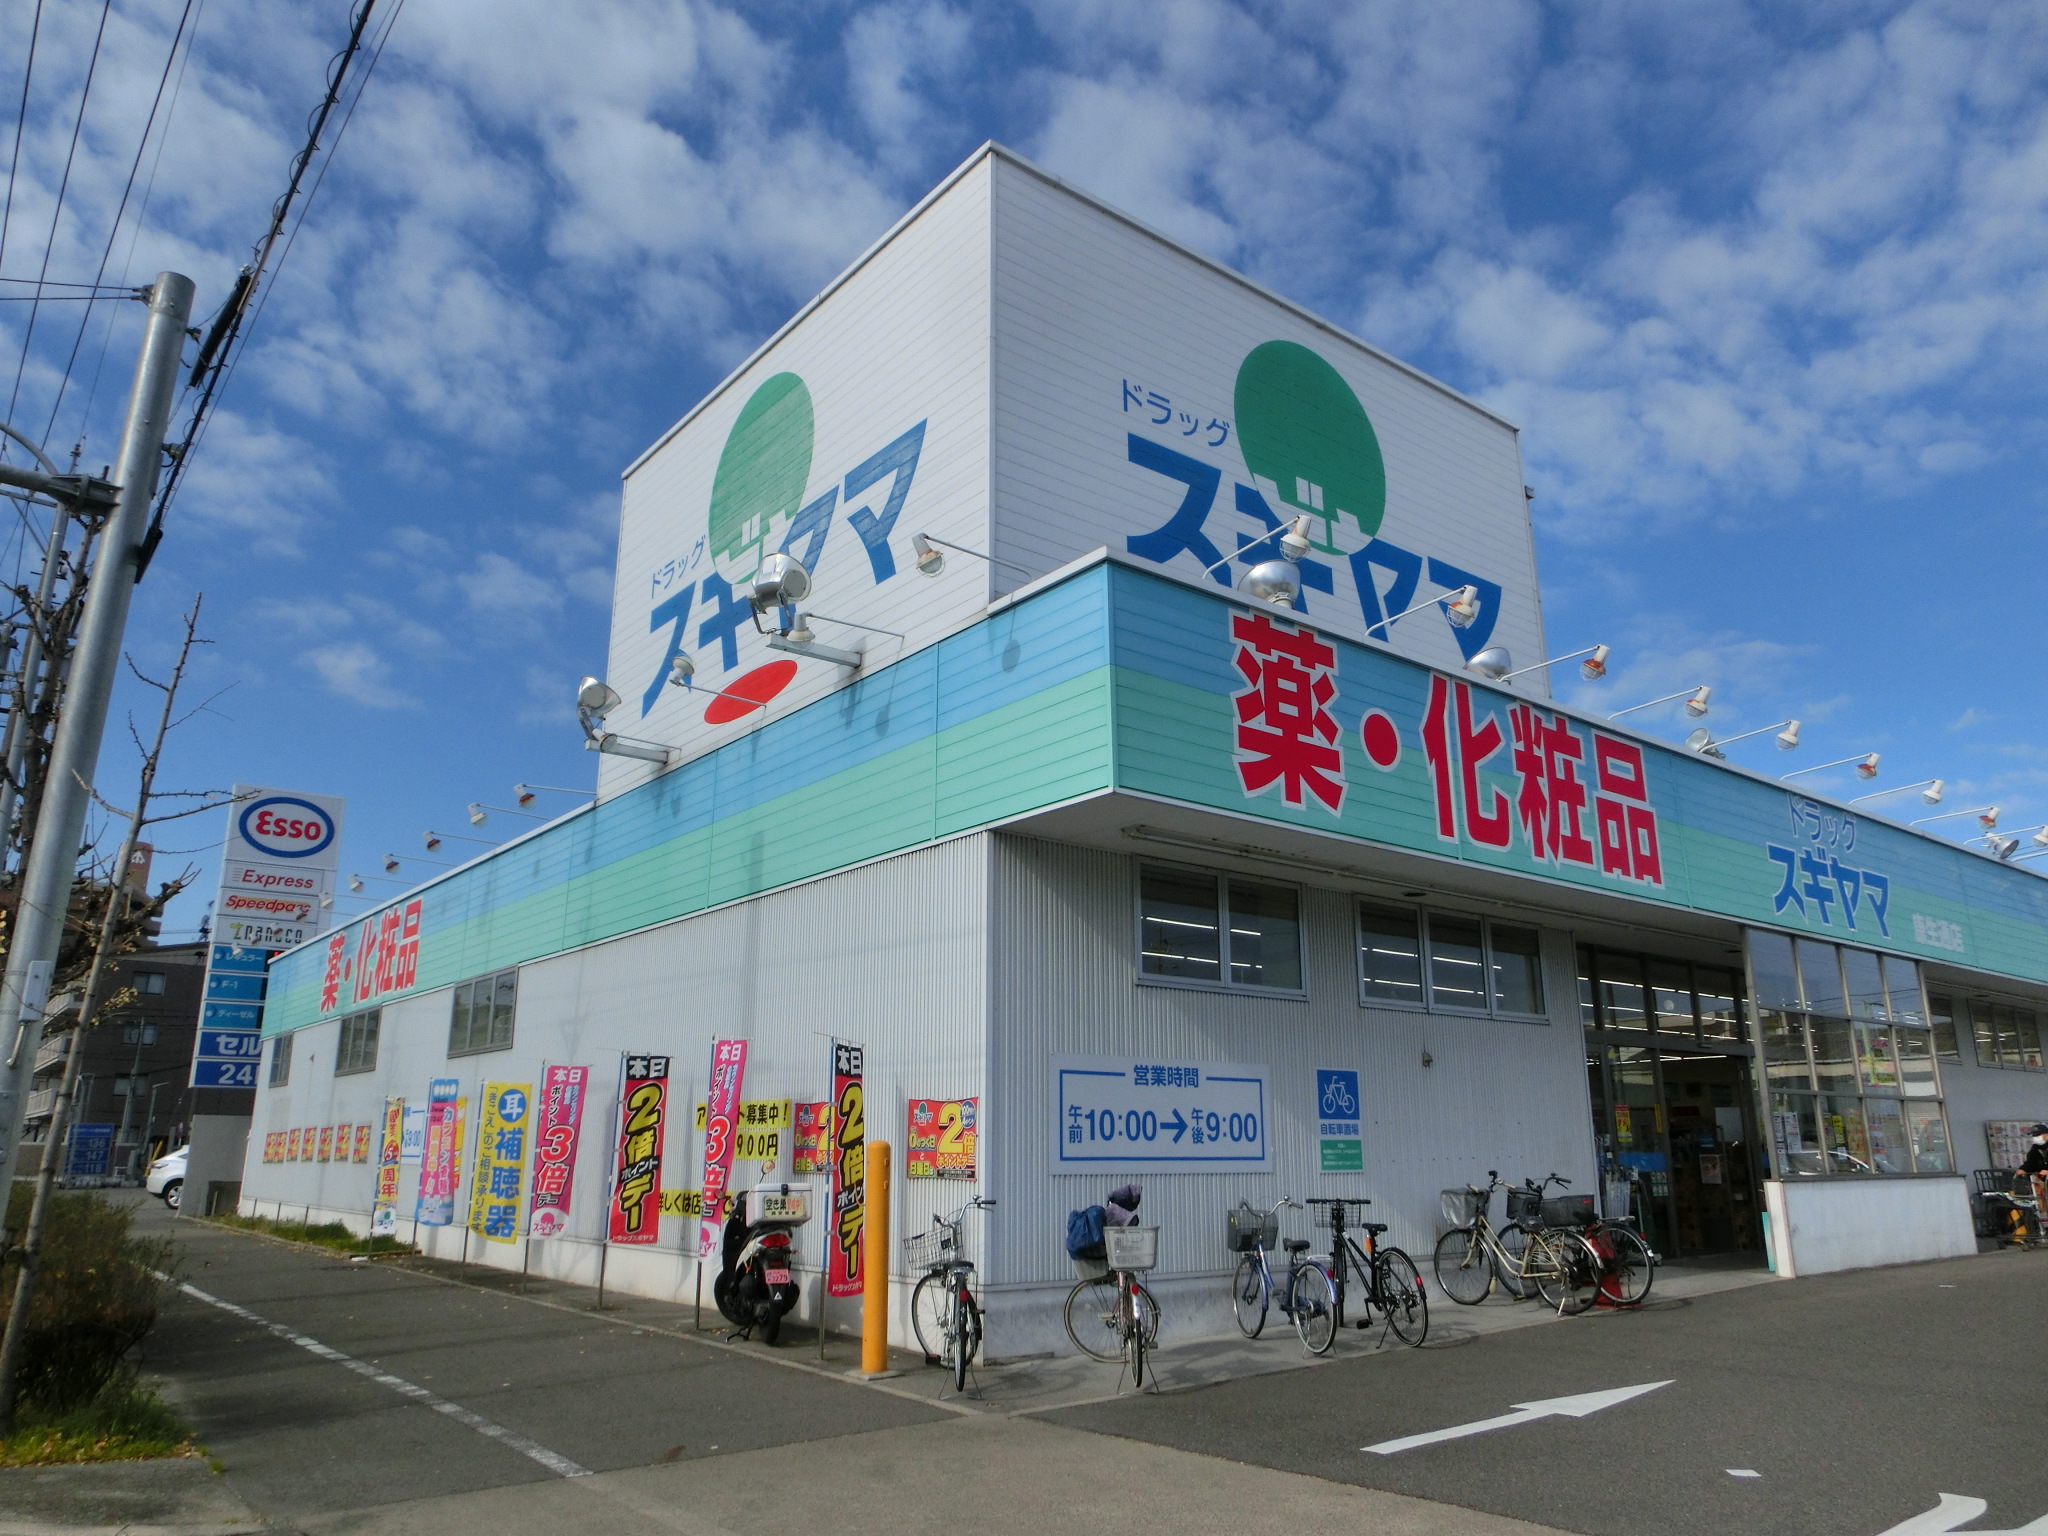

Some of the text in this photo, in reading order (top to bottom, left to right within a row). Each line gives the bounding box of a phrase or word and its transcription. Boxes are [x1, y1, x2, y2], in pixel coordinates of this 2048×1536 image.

[1122, 379, 1230, 447] ドラッグ
[651, 534, 706, 599] ドラッグ
[1230, 610, 1664, 888] 薬・化粧品
[255, 811, 321, 841] Esso
[1787, 792, 1856, 852] ドラッグ
[242, 869, 313, 889] Express
[1766, 842, 1891, 939] スギヤマ
[321, 899, 422, 1014] 薬・化粧品
[222, 980, 238, 989] F-1
[719, 1044, 741, 1061] 本日
[838, 1048, 862, 1076] 本日
[553, 1068, 582, 1083] 本日
[629, 1057, 666, 1079] 本日
[1133, 1065, 1199, 1088] 営業時間
[501, 1093, 524, 1120] 耳
[1068, 1104, 1258, 1145] 午前 10:00 午後 9:00
[1320, 1123, 1359, 1136] 自転車置場
[621, 1158, 659, 1181] ポイント
[920, 1152, 925, 1160] と
[937, 1153, 976, 1168] ポイントデー
[483, 1127, 525, 1238] 補聴器
